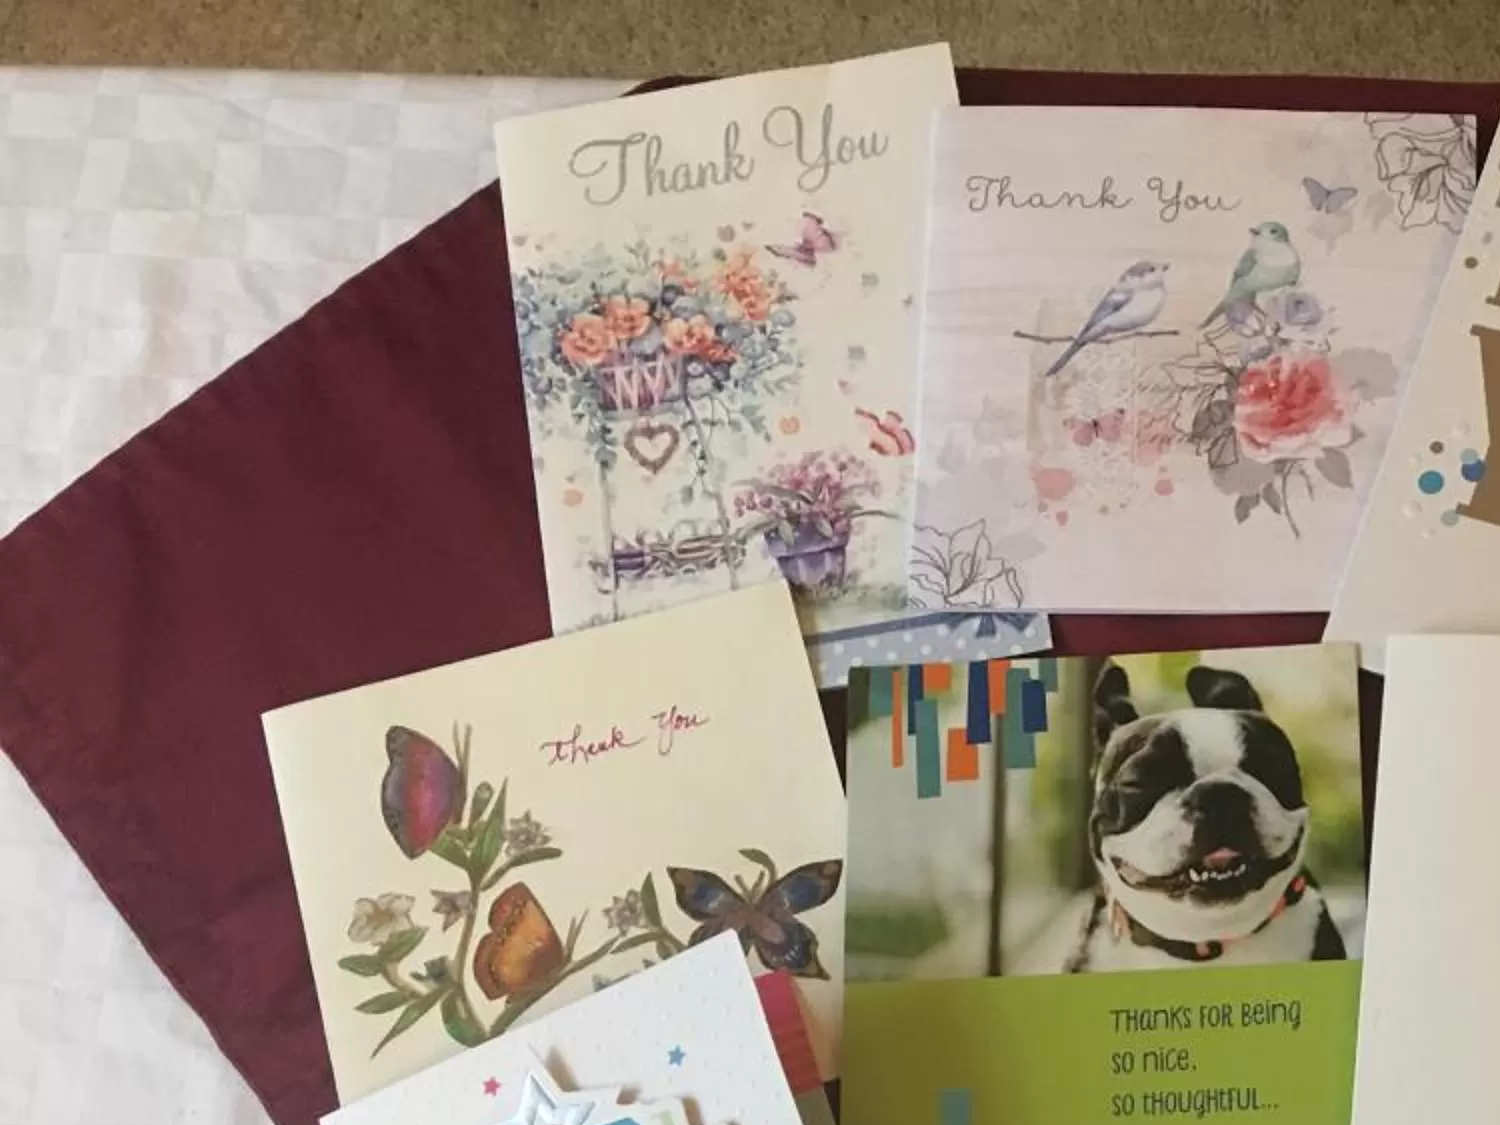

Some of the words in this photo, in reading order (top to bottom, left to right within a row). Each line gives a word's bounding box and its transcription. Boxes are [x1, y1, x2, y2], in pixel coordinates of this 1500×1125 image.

[568, 119, 755, 206] Thank
[762, 103, 889, 193] You
[965, 175, 1135, 213] Thank
[1147, 176, 1241, 223] You
